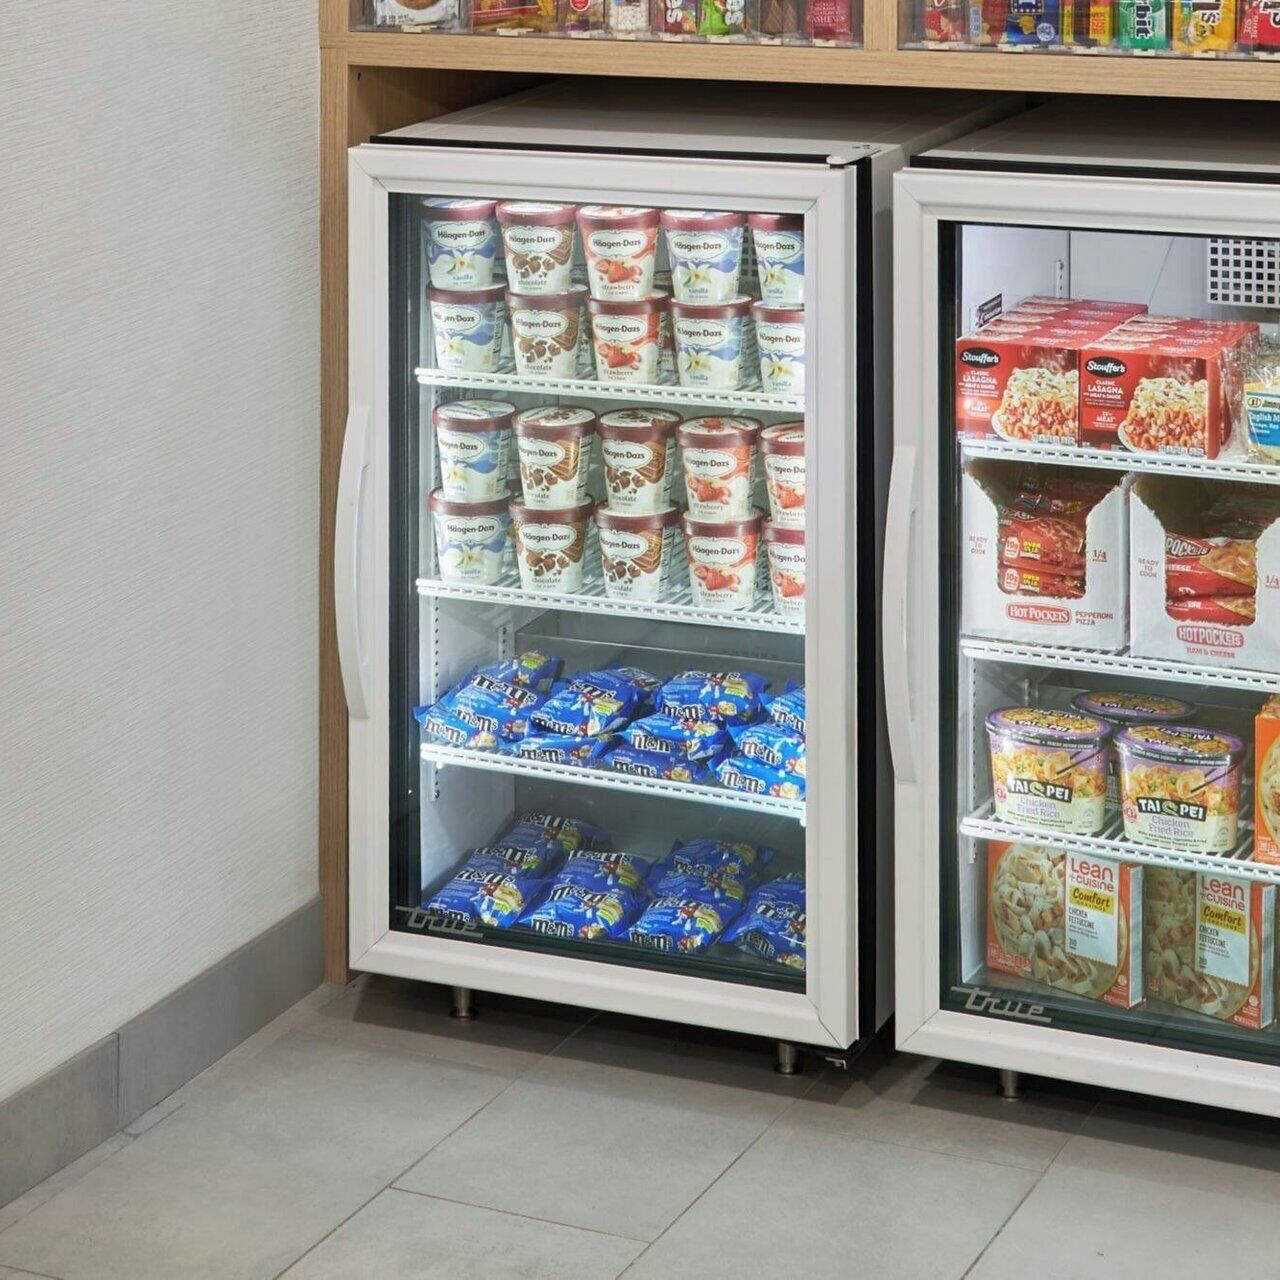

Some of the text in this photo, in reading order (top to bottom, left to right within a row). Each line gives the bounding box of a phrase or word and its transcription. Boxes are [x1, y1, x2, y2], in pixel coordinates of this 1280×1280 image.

[592, 237, 642, 250] Häagen-Dazs
[961, 350, 1000, 364] Stouffer's
[1087, 360, 1126, 374] Stouffer's
[963, 376, 998, 385] LASAGNA
[1088, 385, 1124, 395] LASAGNA
[1262, 400, 1280, 410] Jimmy
[1138, 558, 1160, 566] READY
[1009, 606, 1069, 622] HOT POCKETS
[1076, 610, 1114, 620] PEPPERONI
[1178, 627, 1242, 646] HOT POCKETS
[662, 702, 706, 721] m&m's
[456, 708, 498, 732] m&m's
[531, 716, 575, 736] m&m's
[424, 716, 468, 743] m&m's
[521, 746, 565, 762] m&m's
[742, 740, 782, 764] m&m's
[613, 759, 658, 778] m&m's
[722, 768, 765, 794] m&m's
[1009, 780, 1069, 800] TAI PEI
[1020, 798, 1056, 808] Chicken
[1139, 799, 1204, 819] TAI PEI
[1018, 806, 1060, 818] Fried Rice
[1148, 823, 1194, 838] Fried Rice
[1152, 816, 1190, 829] Chicken
[1070, 857, 1114, 882] Lean
[1201, 875, 1245, 902] Lean
[1072, 888, 1110, 908] Comfort
[1069, 906, 1088, 918] CHICKEN
[1203, 906, 1242, 927] Comfort
[532, 918, 574, 937] m&m's
[1069, 915, 1096, 930] FETTUCCINE
[1199, 924, 1219, 937] CHICKEN
[630, 930, 674, 951] m&m's
[1199, 934, 1226, 948] FETTUCCINE
